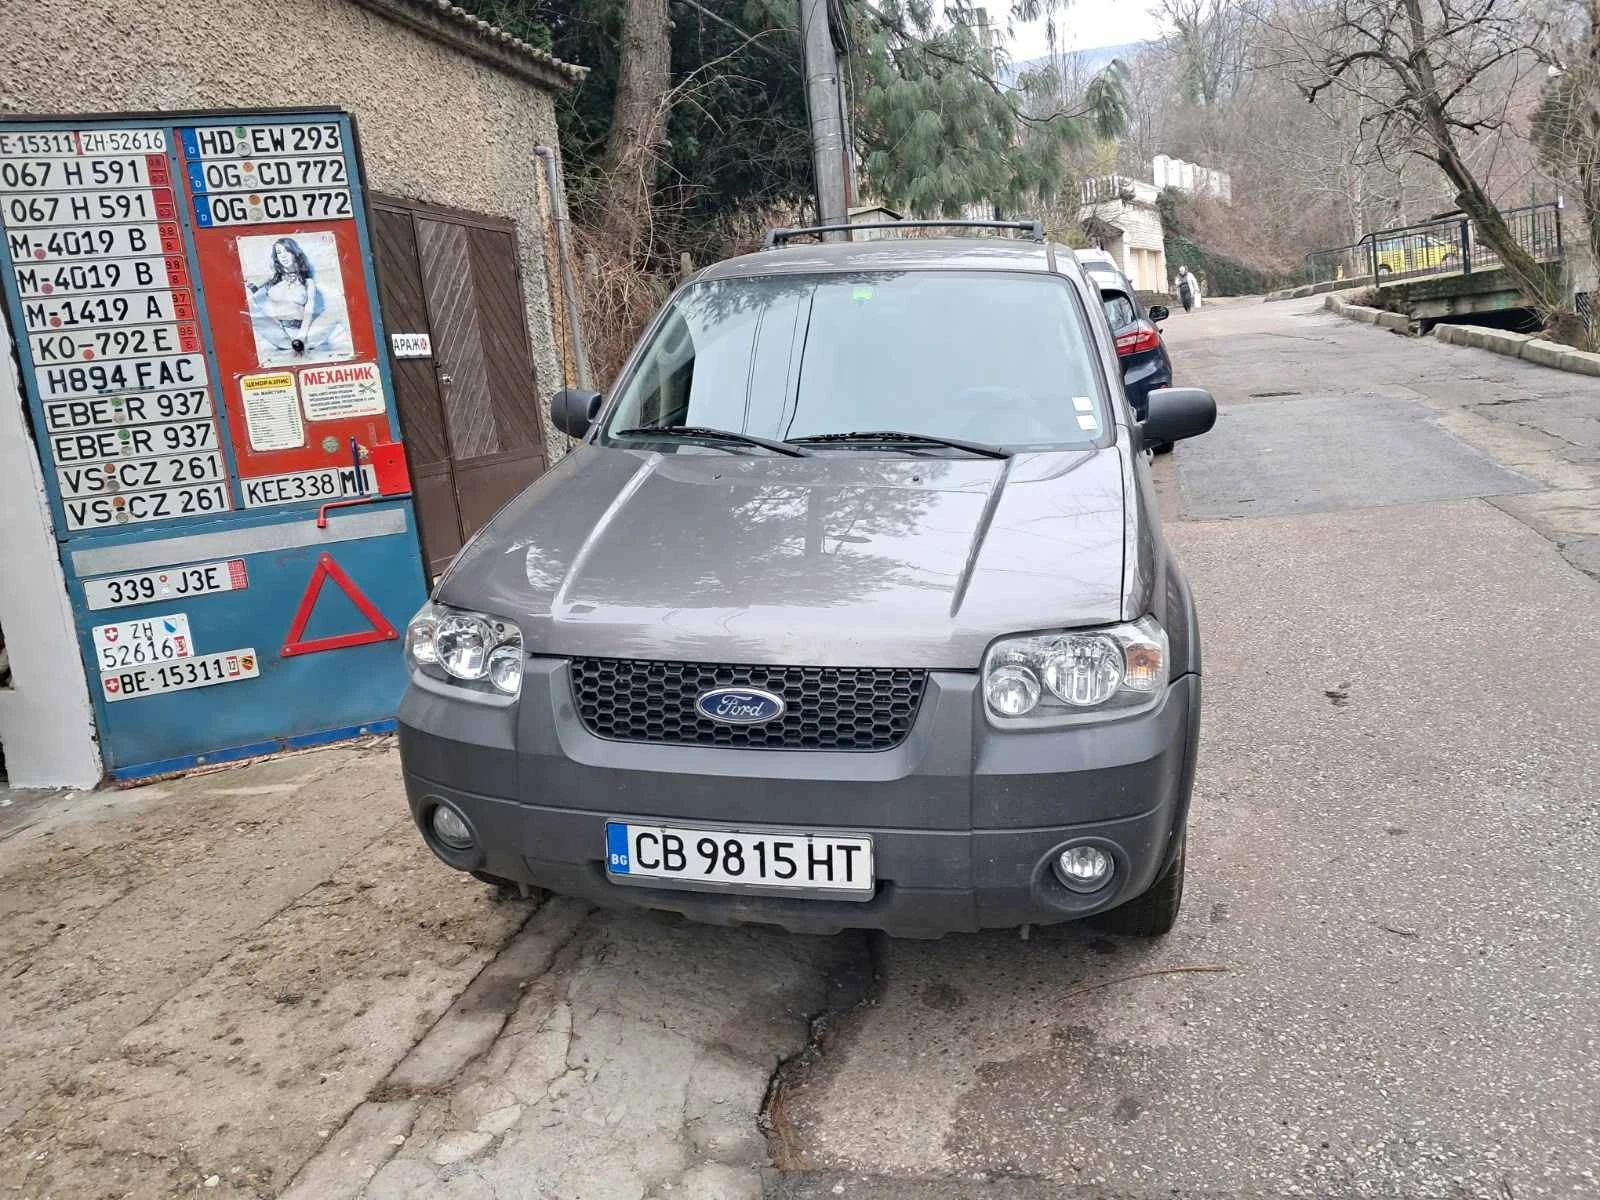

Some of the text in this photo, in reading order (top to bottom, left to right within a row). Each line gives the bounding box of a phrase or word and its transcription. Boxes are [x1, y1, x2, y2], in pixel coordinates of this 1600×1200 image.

[199, 126, 339, 155] HD EW 293
[2, 159, 140, 187] 067 H 591
[206, 159, 345, 188] OG CD 772
[10, 194, 146, 222] 067 H 591
[212, 192, 350, 222] OG CD 772
[128, 228, 147, 252] B
[135, 262, 153, 286] B
[146, 296, 163, 319] A
[154, 328, 172, 351] E
[393, 338, 420, 351] АРАЖ
[48, 358, 194, 394] H894 FAC
[304, 367, 374, 386] МЕХАНИК
[157, 391, 205, 417] 937
[163, 423, 211, 449] 937
[169, 455, 218, 483] 261
[178, 486, 225, 513] 261
[247, 473, 335, 504] KEE338
[107, 577, 155, 603] 339
[176, 567, 220, 594] J3E
[130, 621, 153, 640] ZH
[103, 638, 174, 668] 52616
[716, 693, 765, 717] Ford
[611, 853, 628, 866] BG
[636, 832, 862, 882] CB 9815 HT
